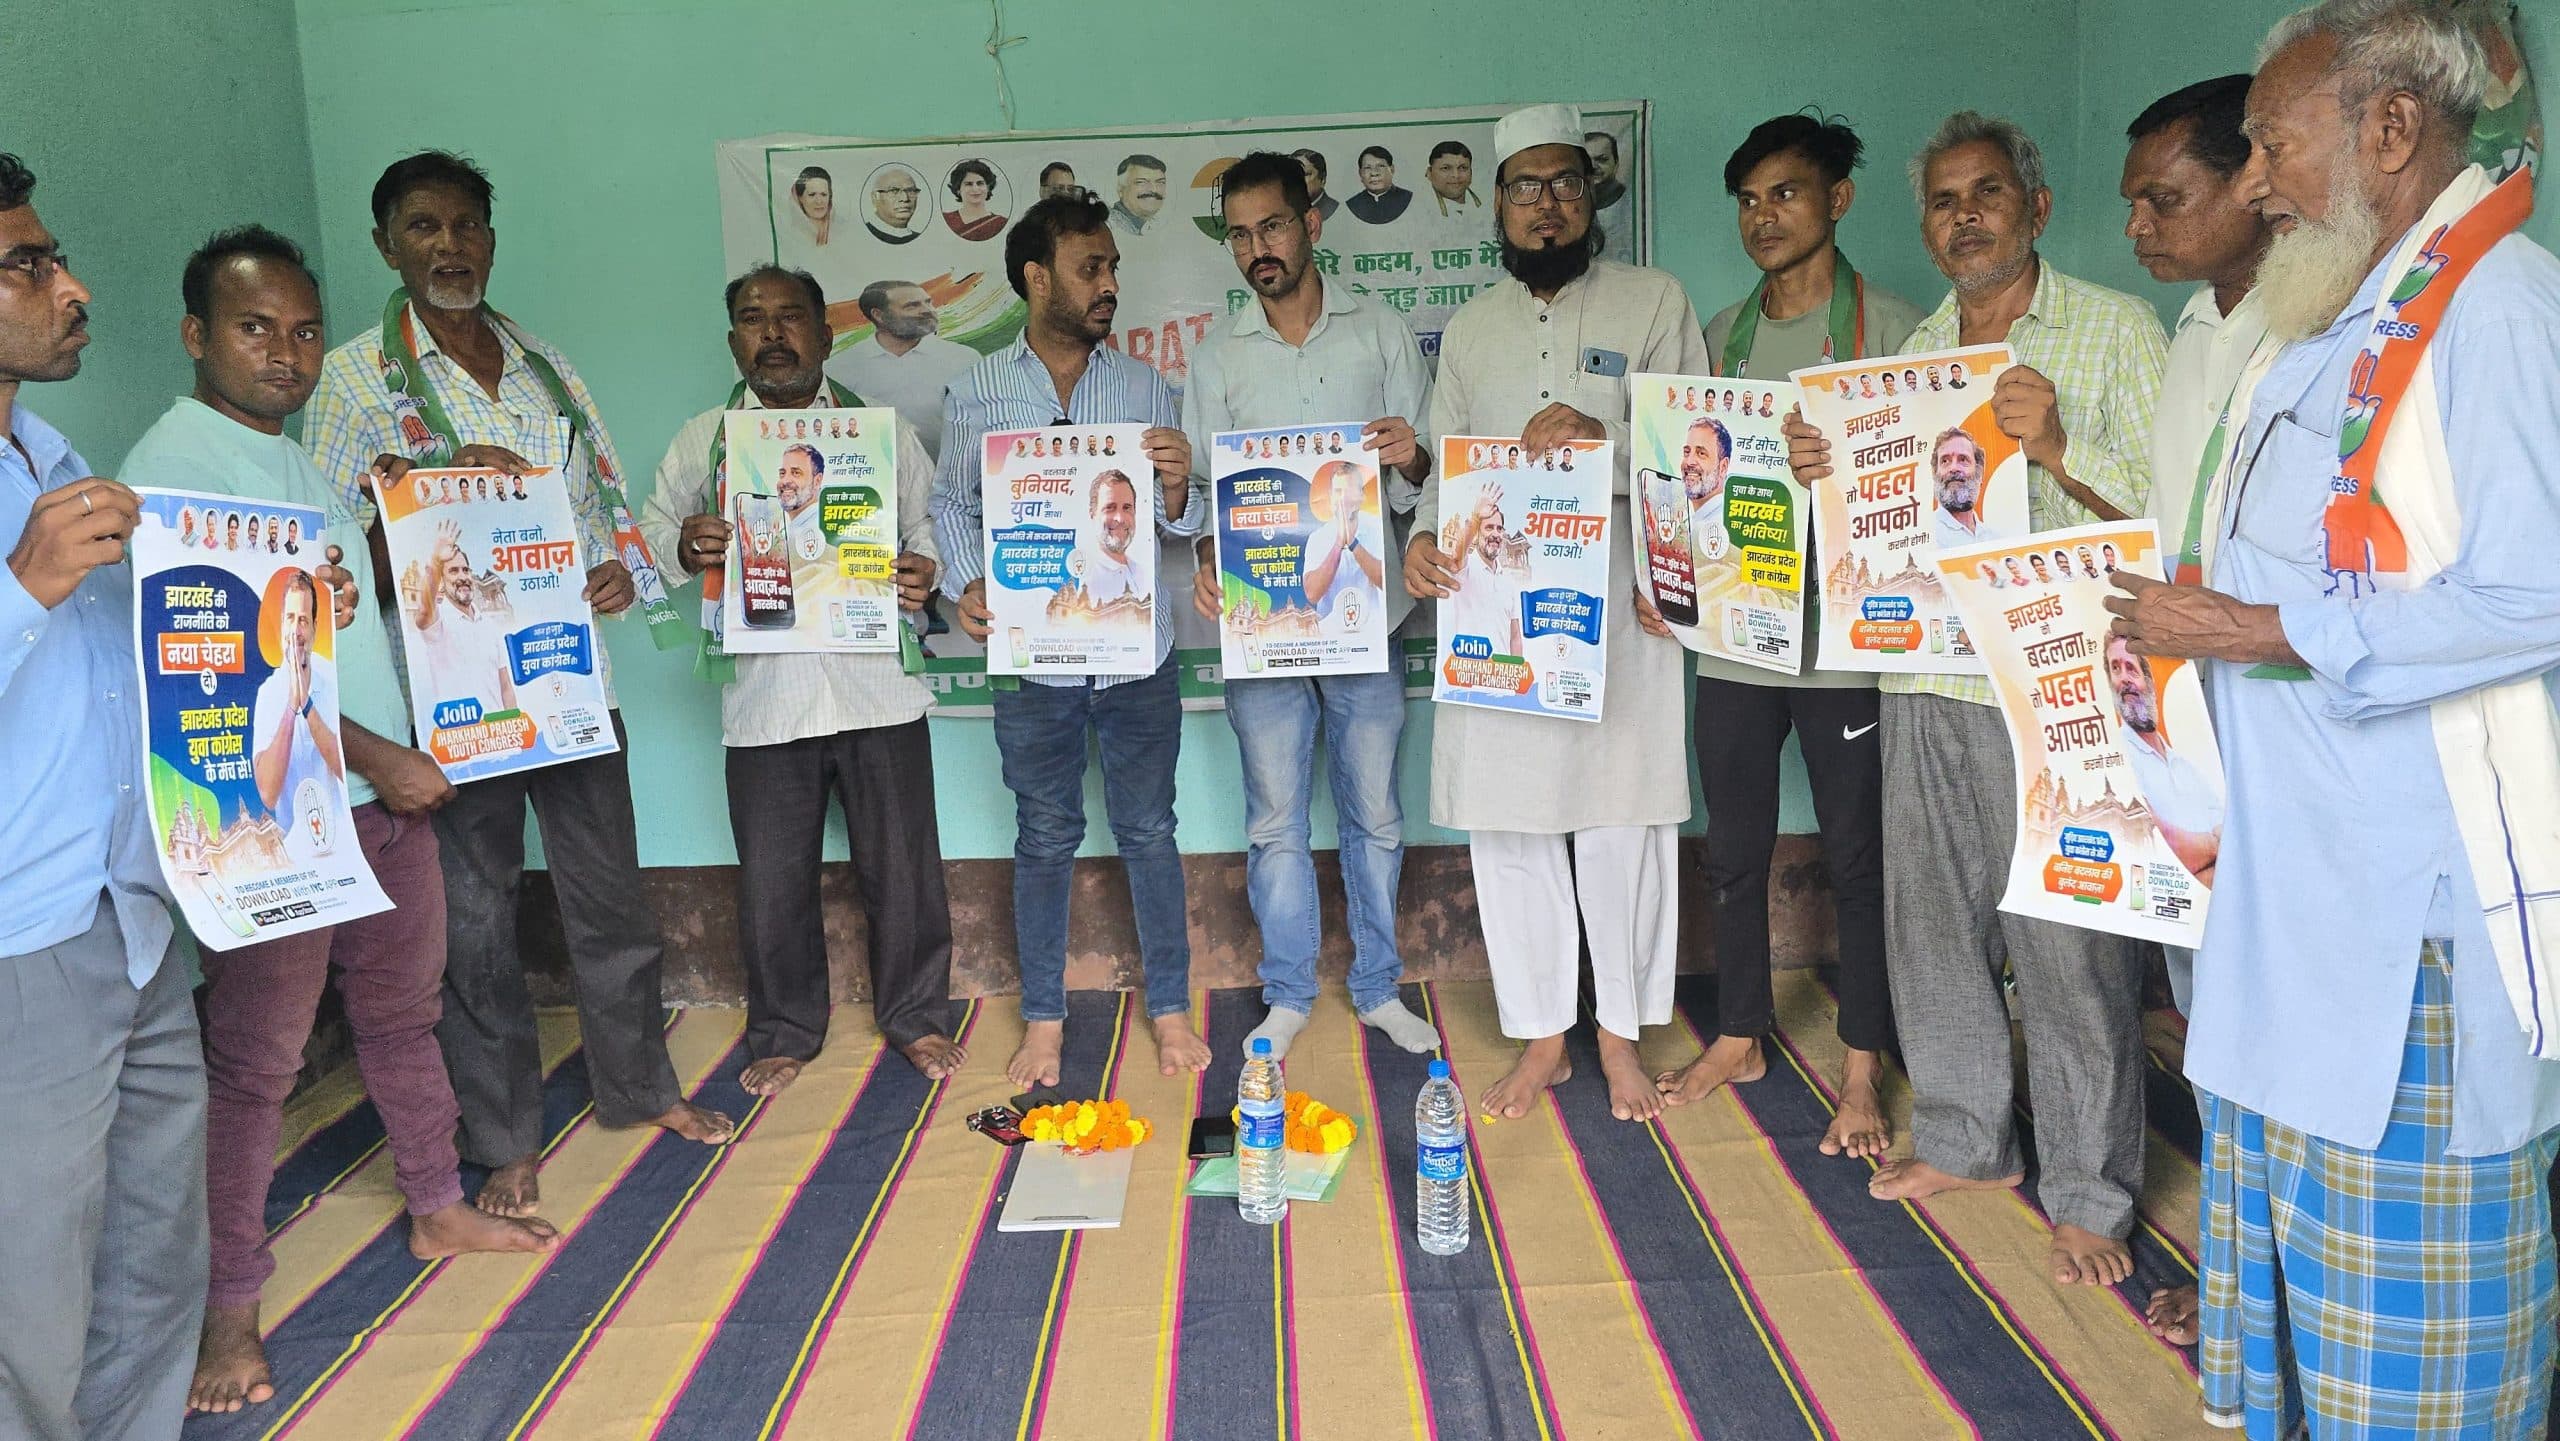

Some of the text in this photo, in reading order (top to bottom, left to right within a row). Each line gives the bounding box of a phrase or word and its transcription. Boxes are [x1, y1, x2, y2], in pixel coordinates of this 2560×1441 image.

[1353, 251, 1422, 276] कदम,
[1432, 249, 1472, 270] एक
[1845, 404, 1901, 438] झारखंड
[1737, 435, 1780, 453] नई सोच,
[1875, 429, 1884, 440] को
[829, 453, 845, 465] नई
[1740, 454, 1755, 462] नया
[1853, 435, 1928, 468] बदलना है?
[1068, 467, 1077, 476] की
[1011, 474, 1074, 500] बुनियाद,
[1233, 476, 1282, 495] झारखंड की
[1733, 485, 1774, 498] युवा के साथ
[1846, 462, 1918, 504] तो पहल
[1044, 500, 1051, 508] के
[1241, 492, 1285, 505] राजनीति को
[1531, 495, 1581, 514] नेता बनो,
[824, 502, 877, 521] झारखंड
[1011, 501, 1042, 523] युवा
[1236, 508, 1291, 524] नया चेहरा
[1729, 499, 1786, 522] झारखंड
[1852, 496, 1920, 539] आपको
[491, 524, 546, 544] नेता बनो,
[826, 523, 837, 531] का
[1524, 512, 1607, 546] आवाज़
[1731, 521, 1788, 543] का भविष्य!
[1544, 542, 1583, 559] उठाओ!
[1888, 532, 1929, 551] करनी होगी!
[492, 541, 574, 573] आवाज़
[843, 547, 889, 558] झारखंड प्रदेश
[1002, 545, 1065, 559] झारखंड प्रदेश
[1244, 543, 1300, 561] झारखंड प्रदेश
[1747, 551, 1796, 568] झारखंड प्रदेश
[848, 562, 885, 575] युवा कांग्रेस
[1006, 561, 1061, 577] युवा कांग्रेस
[1250, 559, 1296, 578] युवा कांग्रेस
[1751, 568, 1791, 584] युवा कांग्रेस
[519, 572, 559, 591] उठाओ!
[1263, 574, 1301, 588] के मंच से!
[165, 581, 227, 609] झारखंड की
[1536, 601, 1591, 617] झारखंड प्रदेश
[2004, 592, 2063, 632] झारखंड
[173, 611, 229, 629] राजनीति को
[1533, 616, 1549, 632] युवा
[1551, 617, 1579, 632] कांग्रेस
[1748, 619, 1786, 632] DOWNLOAD
[165, 637, 235, 666] नया चेहरा
[522, 635, 578, 655] झारखंड प्रदेश
[1029, 644, 1073, 652] DOWNLOAD
[1262, 648, 1307, 656] DOWNLOAD
[1456, 639, 1488, 656] Join
[2023, 632, 2086, 668] बदलना
[521, 659, 540, 675] युवा
[541, 653, 571, 667] कांग्रेस
[1450, 659, 1492, 674] JHARKHAND
[1494, 665, 1528, 679] PRADESH
[1456, 673, 1520, 690] YOUTH CONGRESS
[1560, 680, 1591, 688] DOWNLOAD
[2030, 666, 2096, 709] तो पहल
[179, 701, 248, 733] झारखंड प्रदेश
[440, 704, 477, 725] Join
[436, 719, 529, 747] JHARKHAND PRADESH
[2045, 705, 2108, 752] आपको
[188, 730, 243, 765] युवा कांग्रेस
[447, 733, 524, 759] YOUTH CONGRESS
[204, 755, 252, 782] के मंच से!
[2083, 754, 2104, 770] करनी
[245, 881, 269, 892] BECOME
[275, 875, 300, 886] MEMBER
[2148, 877, 2189, 890] DOWNLOAD
[236, 888, 291, 910] DOWNLOAD
[312, 883, 324, 893] IYC
